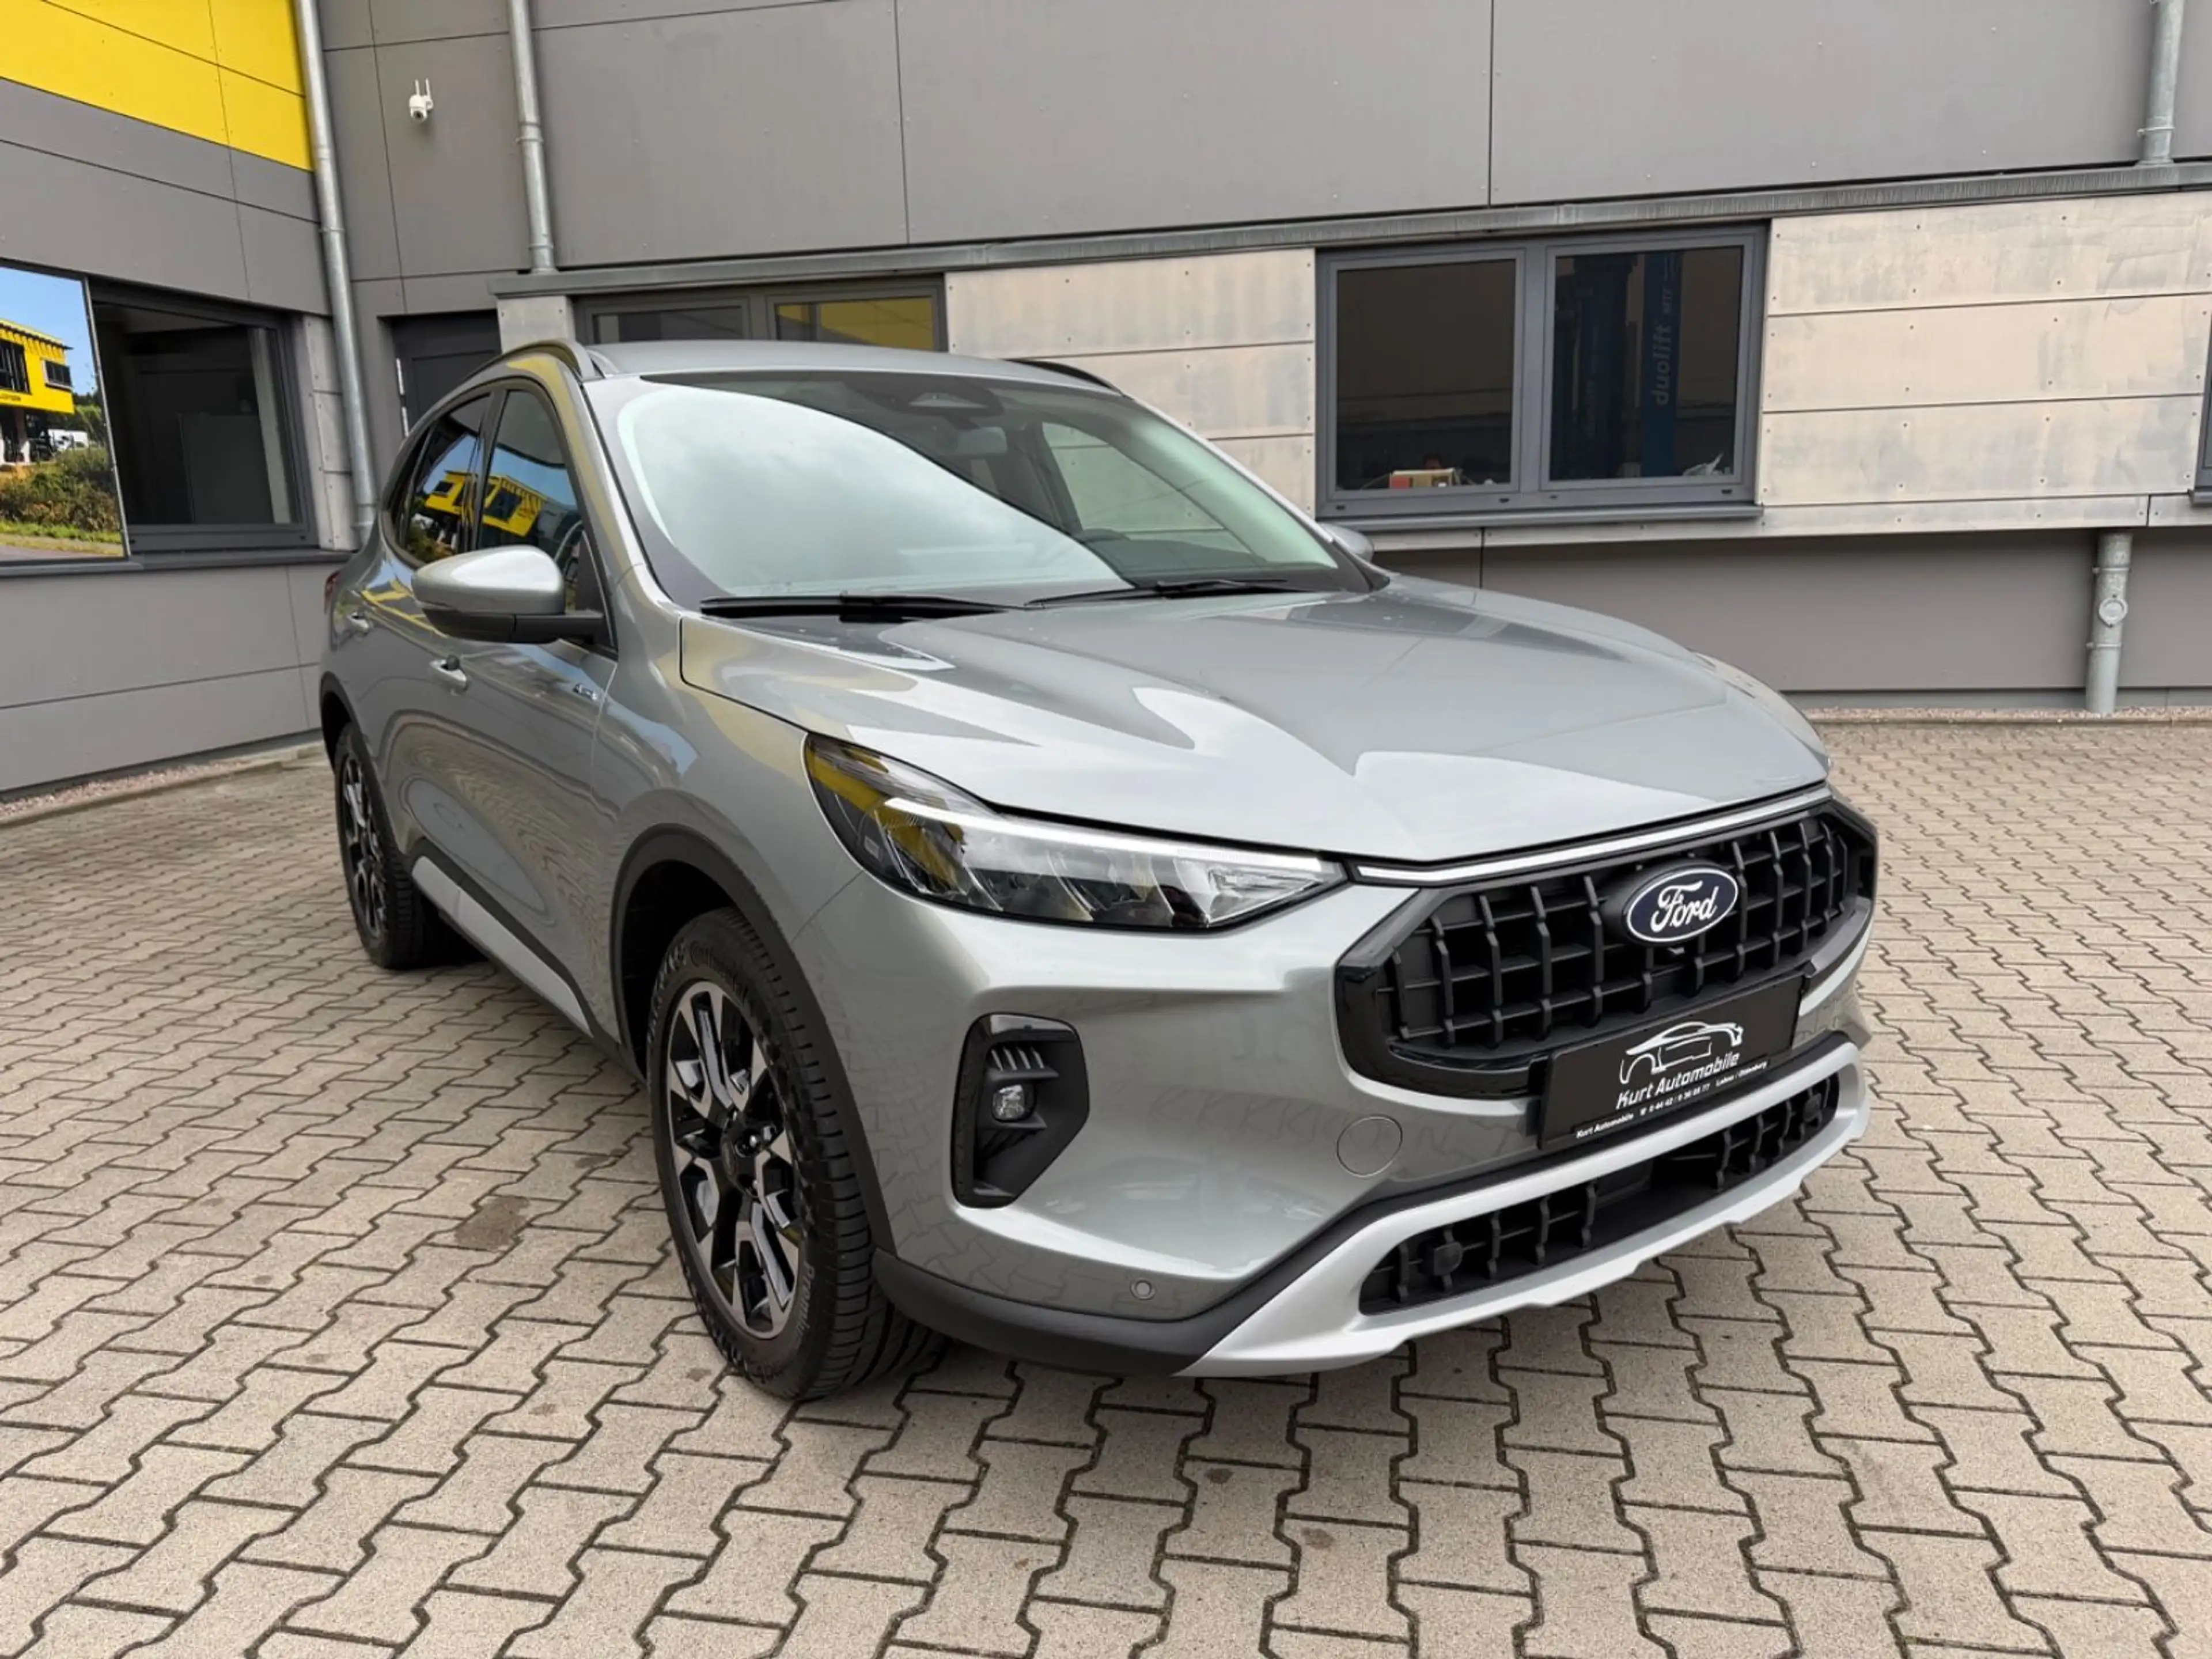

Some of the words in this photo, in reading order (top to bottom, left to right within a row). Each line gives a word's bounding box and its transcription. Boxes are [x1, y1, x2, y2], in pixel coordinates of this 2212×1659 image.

[1652, 325, 1671, 406] duolift
[1650, 880, 1719, 932] Ford
[1615, 1082, 1654, 1109] Kurt
[1654, 1051, 1740, 1096] Automobile
[1576, 1127, 1593, 1139] Kurt
